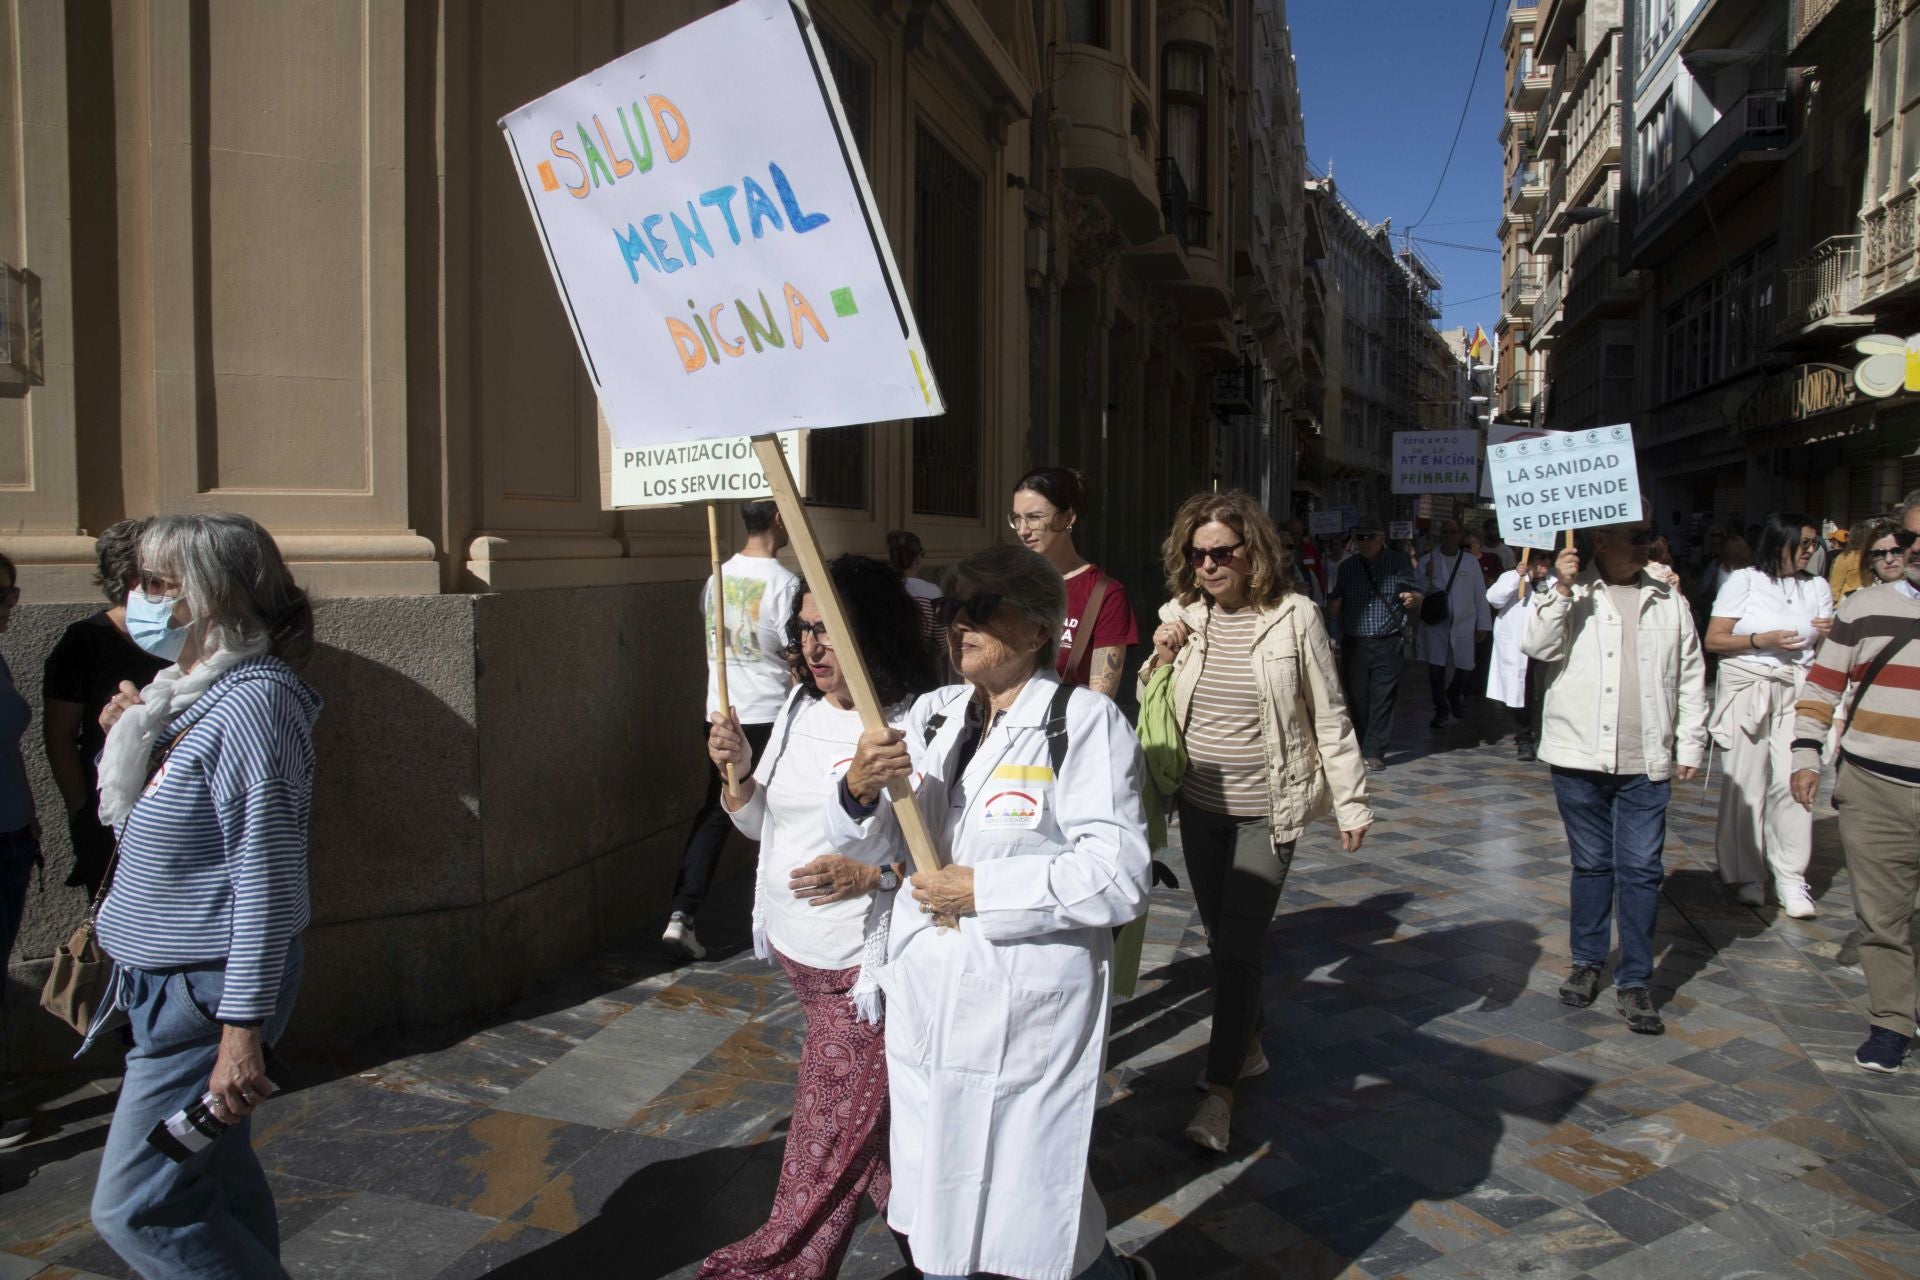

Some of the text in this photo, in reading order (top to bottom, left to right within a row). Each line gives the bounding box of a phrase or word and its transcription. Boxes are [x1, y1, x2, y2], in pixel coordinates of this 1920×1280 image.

[551, 94, 691, 199] SALUD
[612, 160, 830, 284] MENTAL
[1507, 454, 1619, 483] LA SANIDAD
[643, 472, 769, 497] LOS SERVICIOS
[1506, 478, 1628, 508] NO SE VENDE
[1513, 503, 1628, 531] SE DEFIENDE
